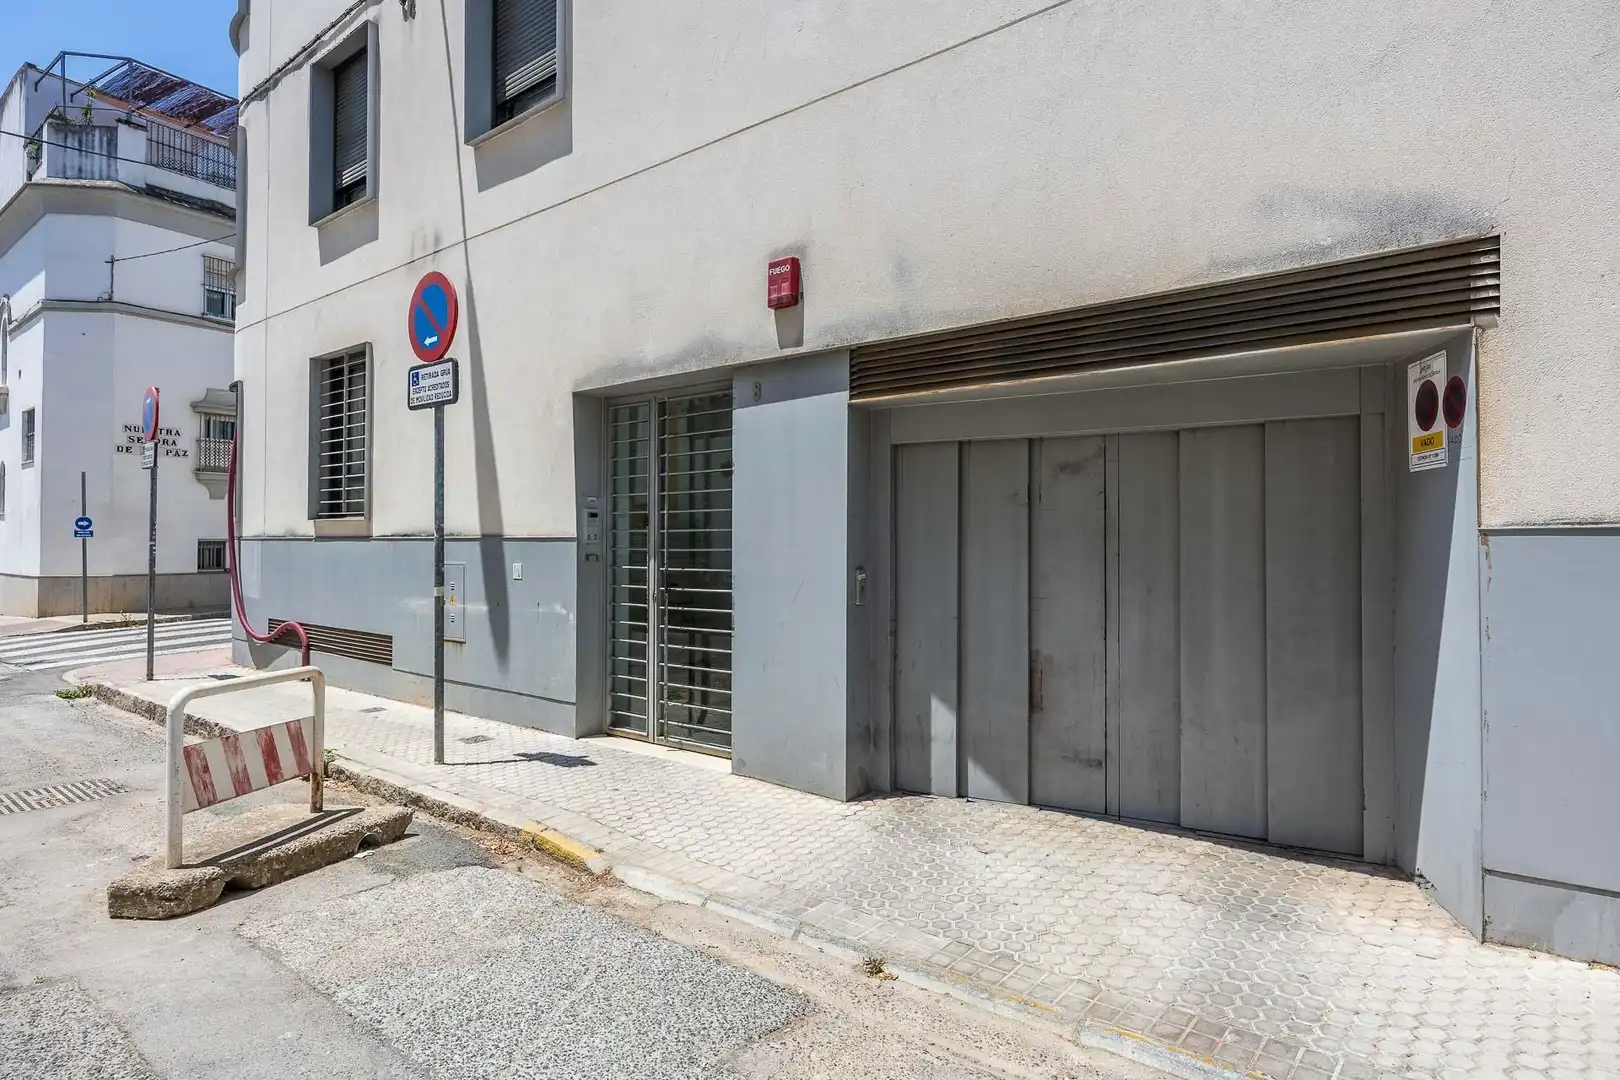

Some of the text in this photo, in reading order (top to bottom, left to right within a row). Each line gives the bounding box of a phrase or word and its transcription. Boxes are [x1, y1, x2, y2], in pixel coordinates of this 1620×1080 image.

[769, 264, 791, 276] FUEGO
[124, 425, 181, 437] NUTRA
[128, 435, 177, 446] SEORA
[1420, 436, 1435, 448] VADO
[117, 445, 132, 454] DE
